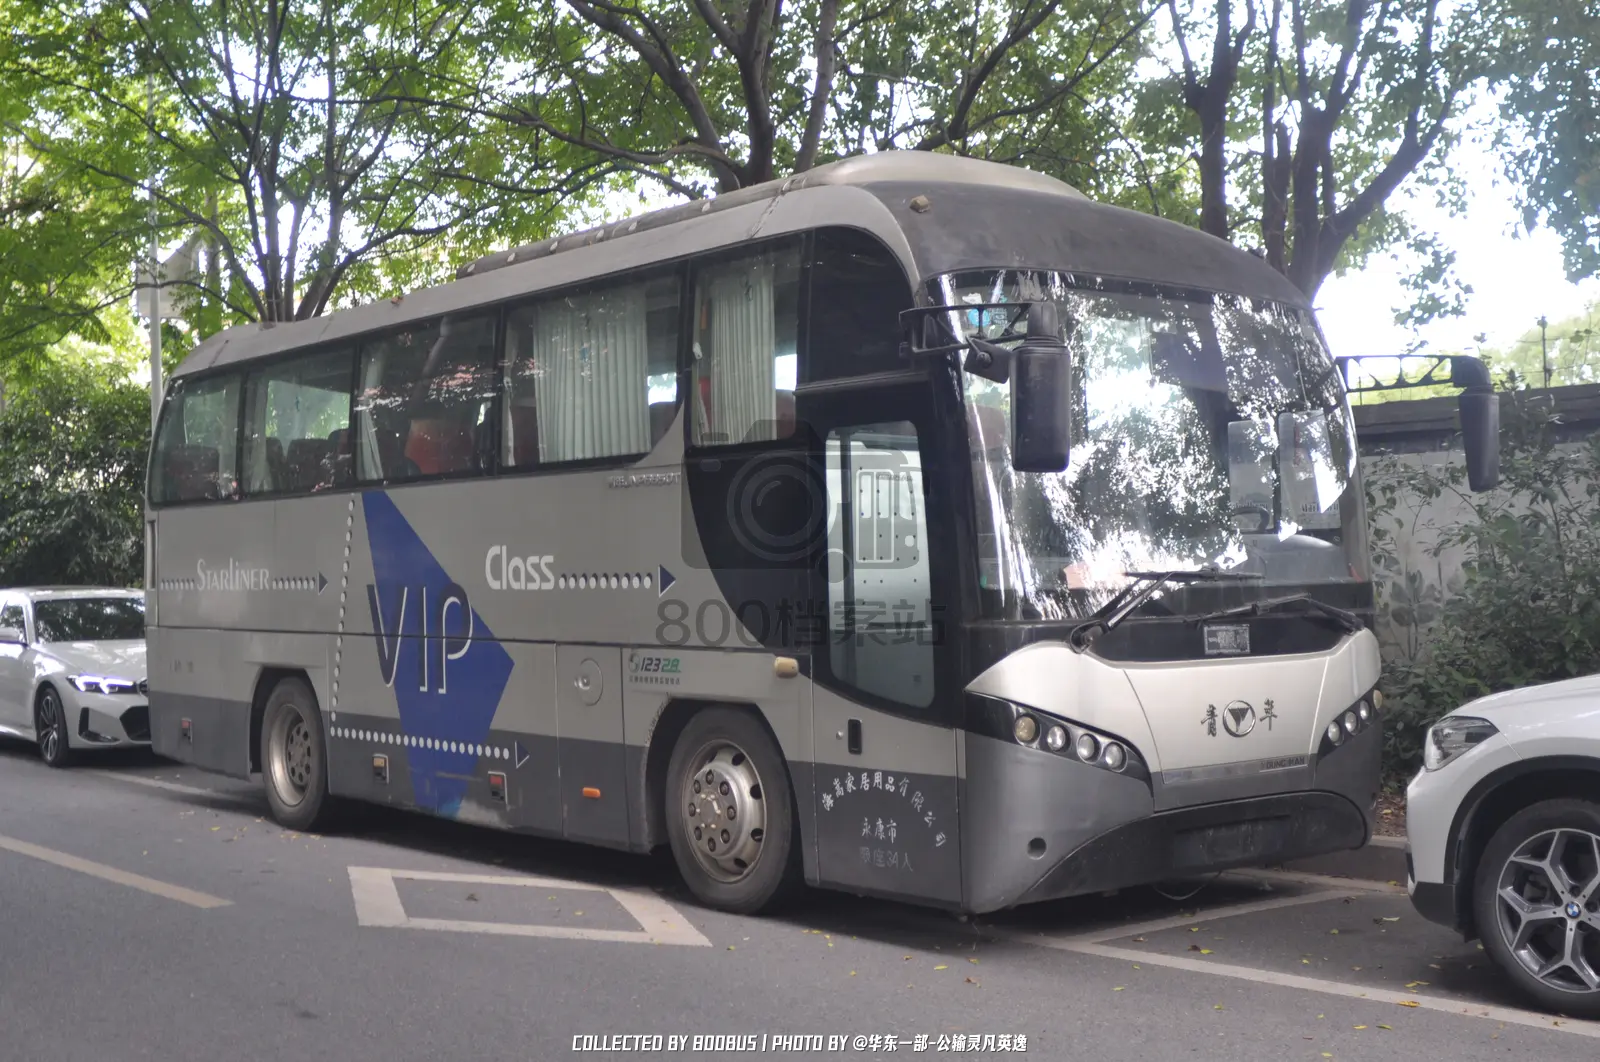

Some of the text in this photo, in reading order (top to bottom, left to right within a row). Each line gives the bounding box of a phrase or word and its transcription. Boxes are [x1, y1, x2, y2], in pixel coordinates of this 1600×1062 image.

[485, 545, 555, 590] Class
[370, 586, 474, 694] VIP
[640, 656, 681, 673] 12328
[861, 817, 898, 844] 永康市
